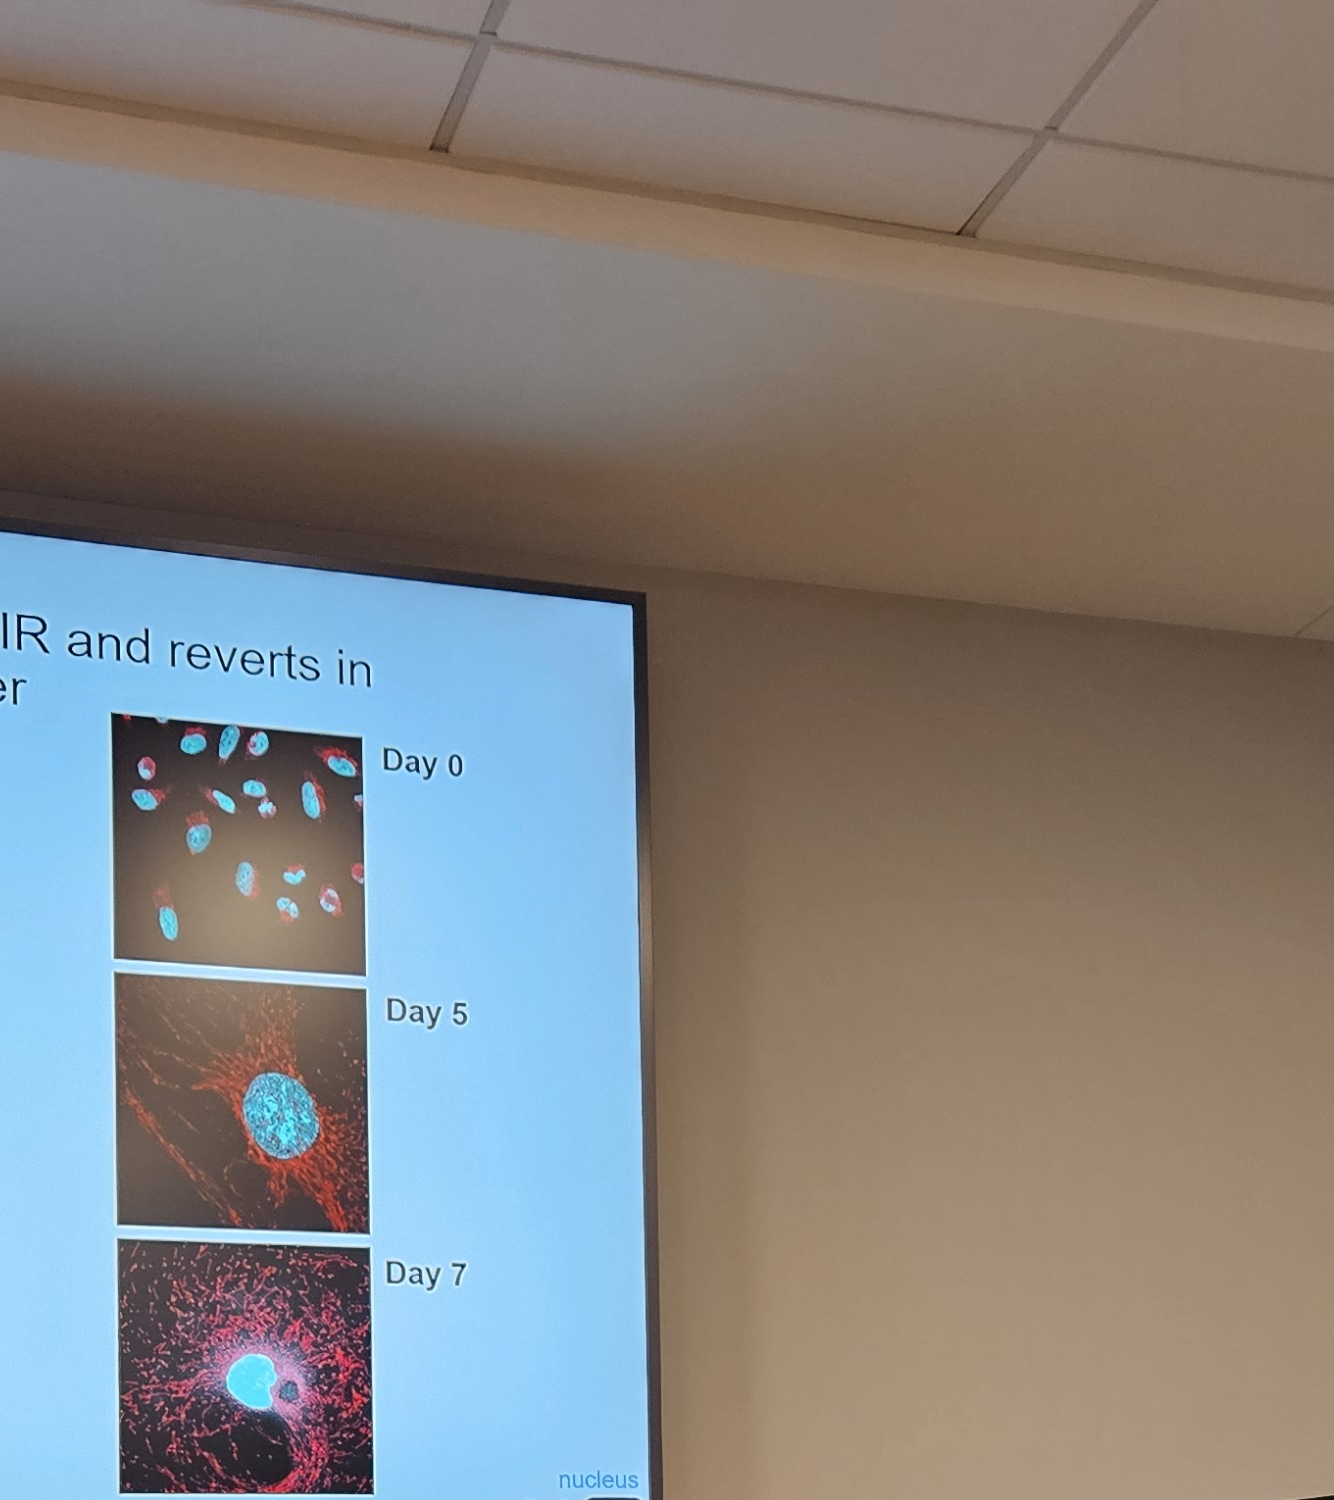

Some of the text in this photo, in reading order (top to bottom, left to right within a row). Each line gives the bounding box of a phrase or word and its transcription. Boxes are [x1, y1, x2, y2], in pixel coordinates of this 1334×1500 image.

[67, 627, 150, 665] and
[170, 640, 321, 682] reverts
[338, 648, 372, 688] in
[383, 746, 463, 781] Day 0
[387, 997, 468, 1030] Day 5
[386, 1260, 467, 1291] Day 7
[558, 1469, 639, 1489] nucleus
